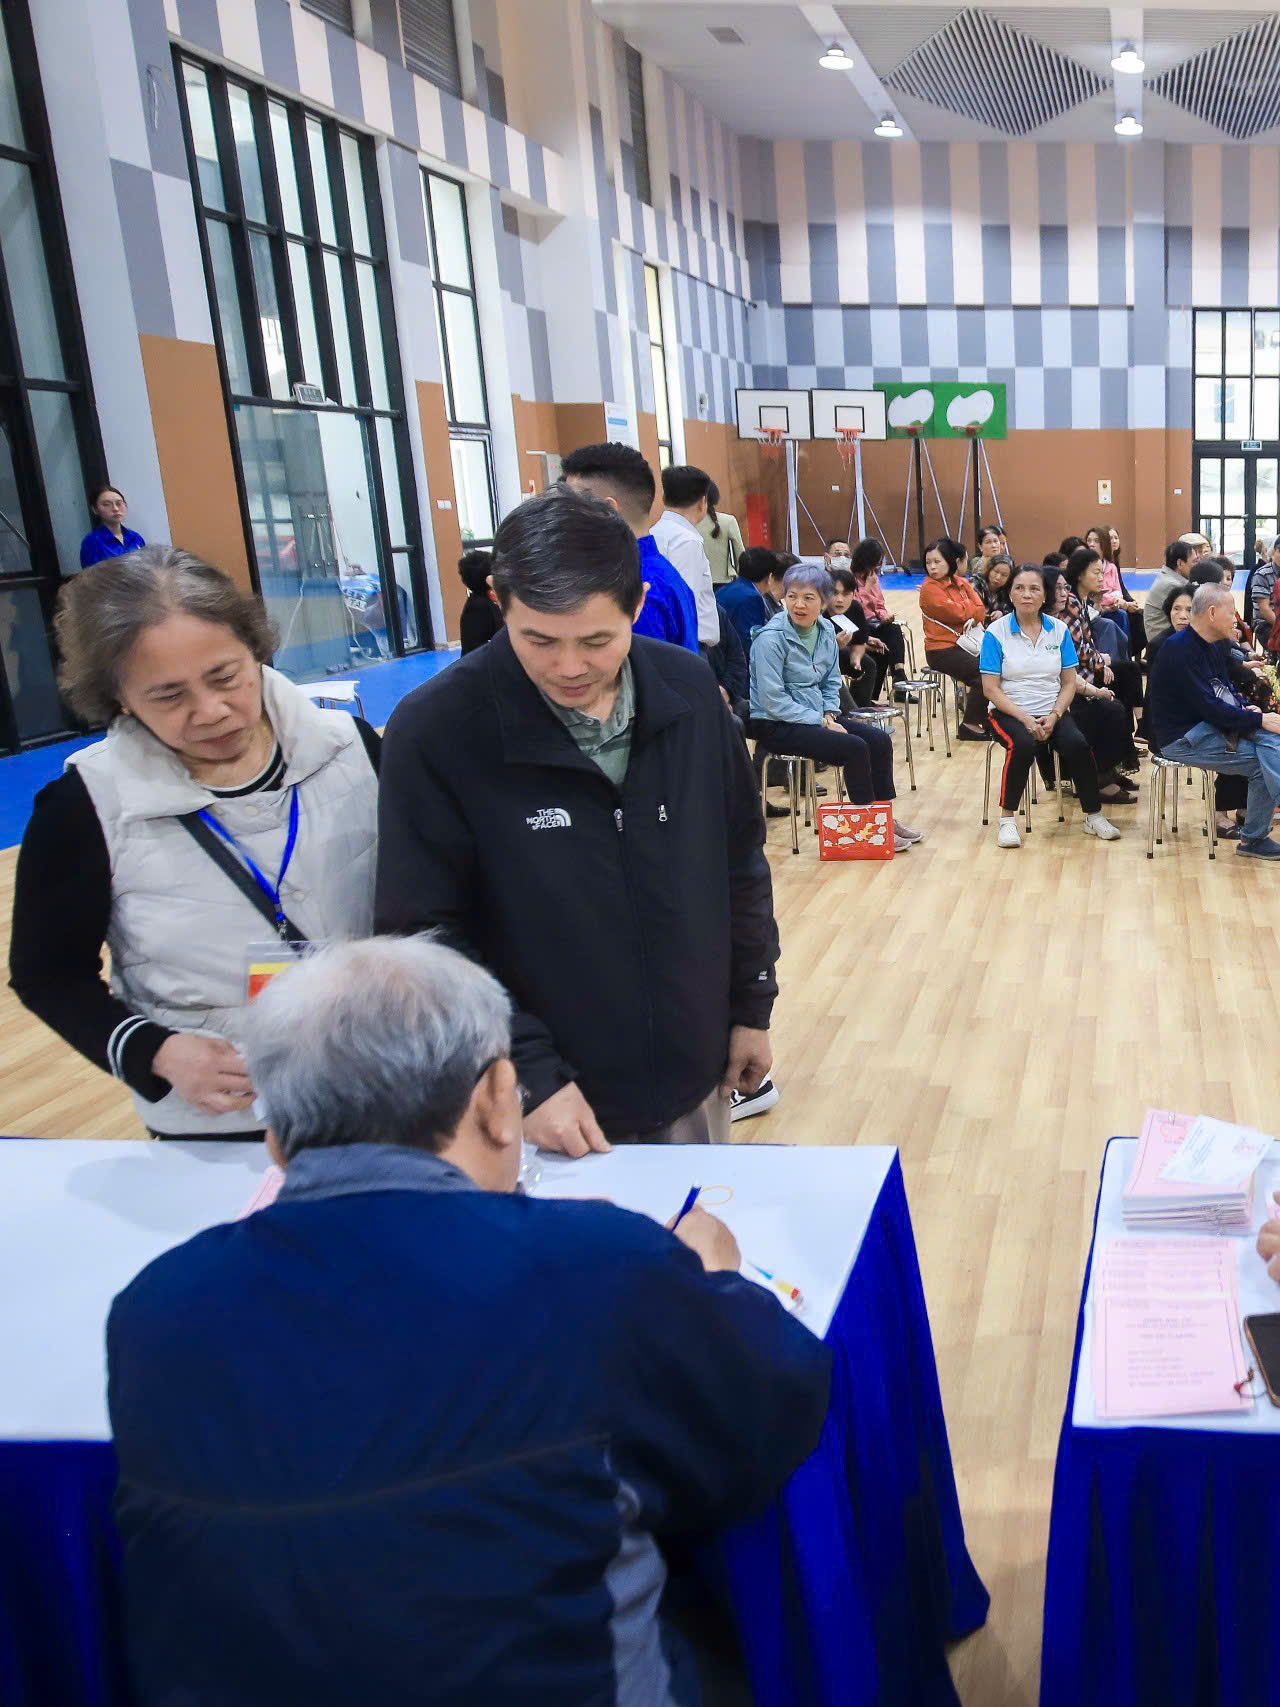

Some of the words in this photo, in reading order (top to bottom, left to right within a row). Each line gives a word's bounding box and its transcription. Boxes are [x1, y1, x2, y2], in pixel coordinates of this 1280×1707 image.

[537, 809, 555, 817] THE
[526, 815, 557, 824] NORTH
[532, 820, 560, 830] FACE
